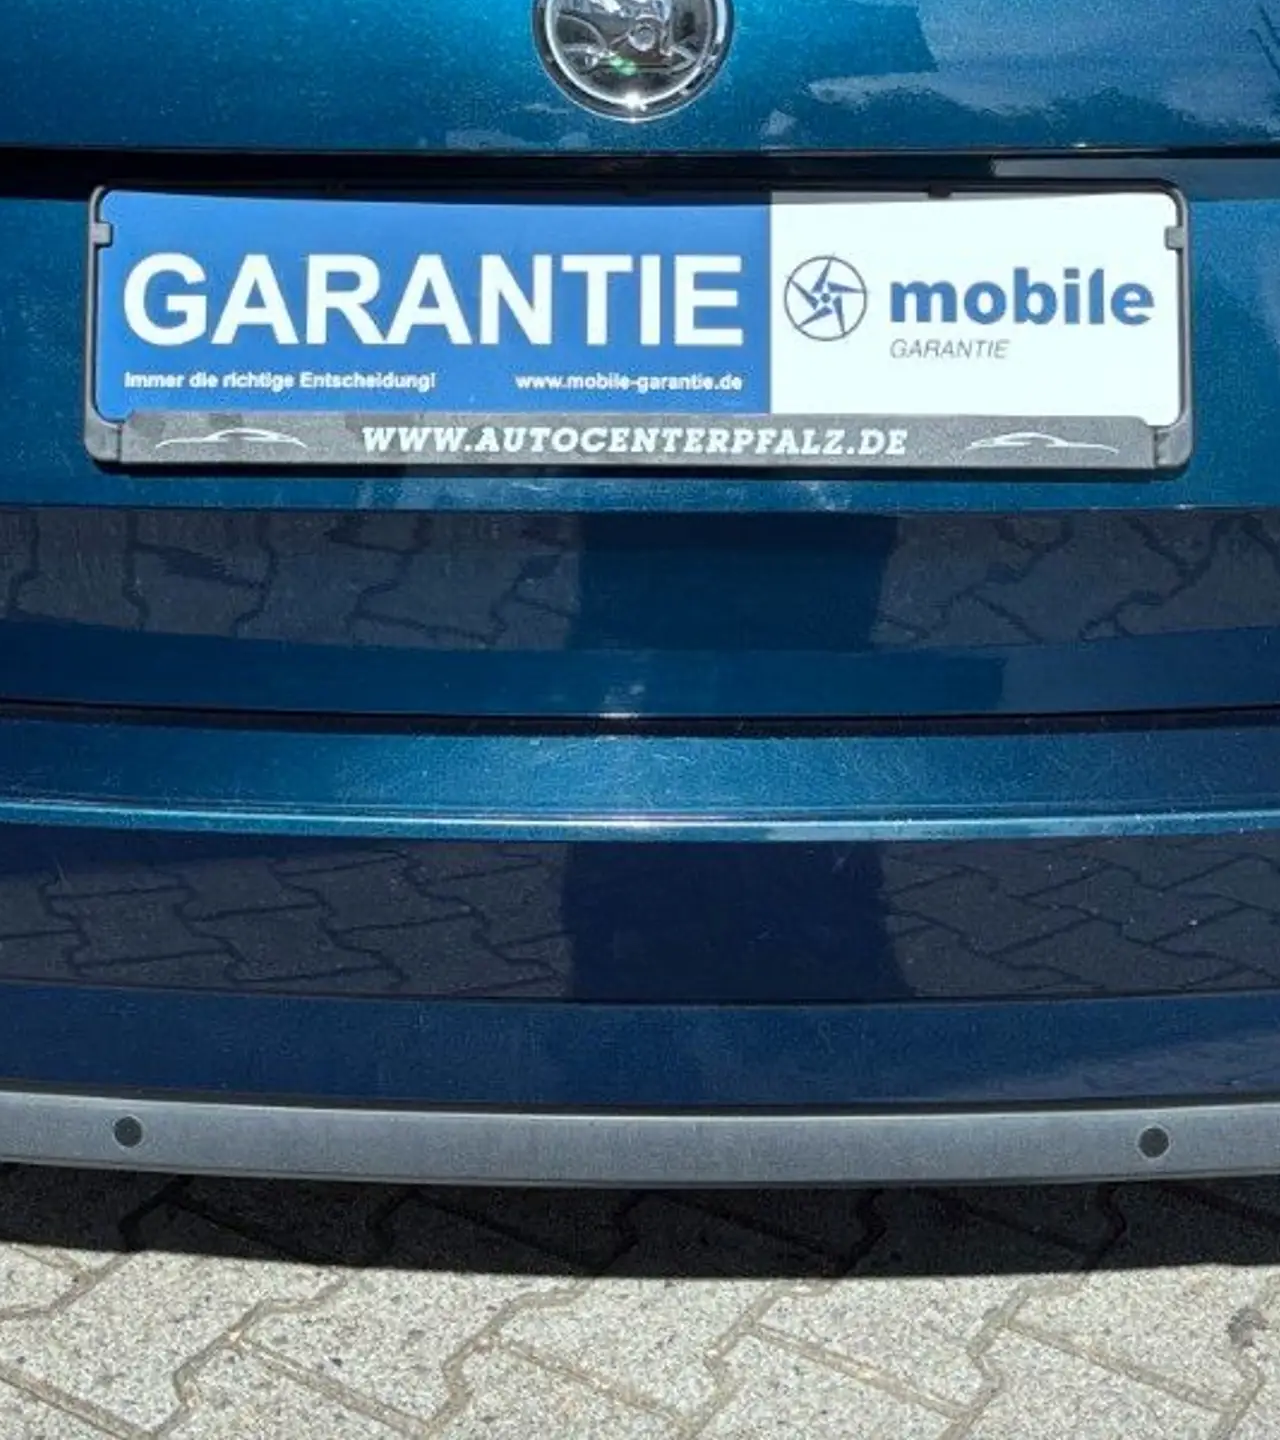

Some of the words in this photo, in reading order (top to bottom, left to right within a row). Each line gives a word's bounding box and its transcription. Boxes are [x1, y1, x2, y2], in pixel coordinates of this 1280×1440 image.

[123, 252, 744, 347] GARANTIE
[889, 266, 1156, 327] mobile
[889, 338, 1011, 360] GARANTIE
[124, 371, 185, 389] Immer
[188, 371, 219, 389] die
[222, 371, 296, 393] richtige
[299, 371, 437, 393] Entscheidung!
[515, 372, 743, 394] www.mobile-garantie.de
[362, 424, 909, 456] WWW.AUTOCENTERPFALZ.DE
